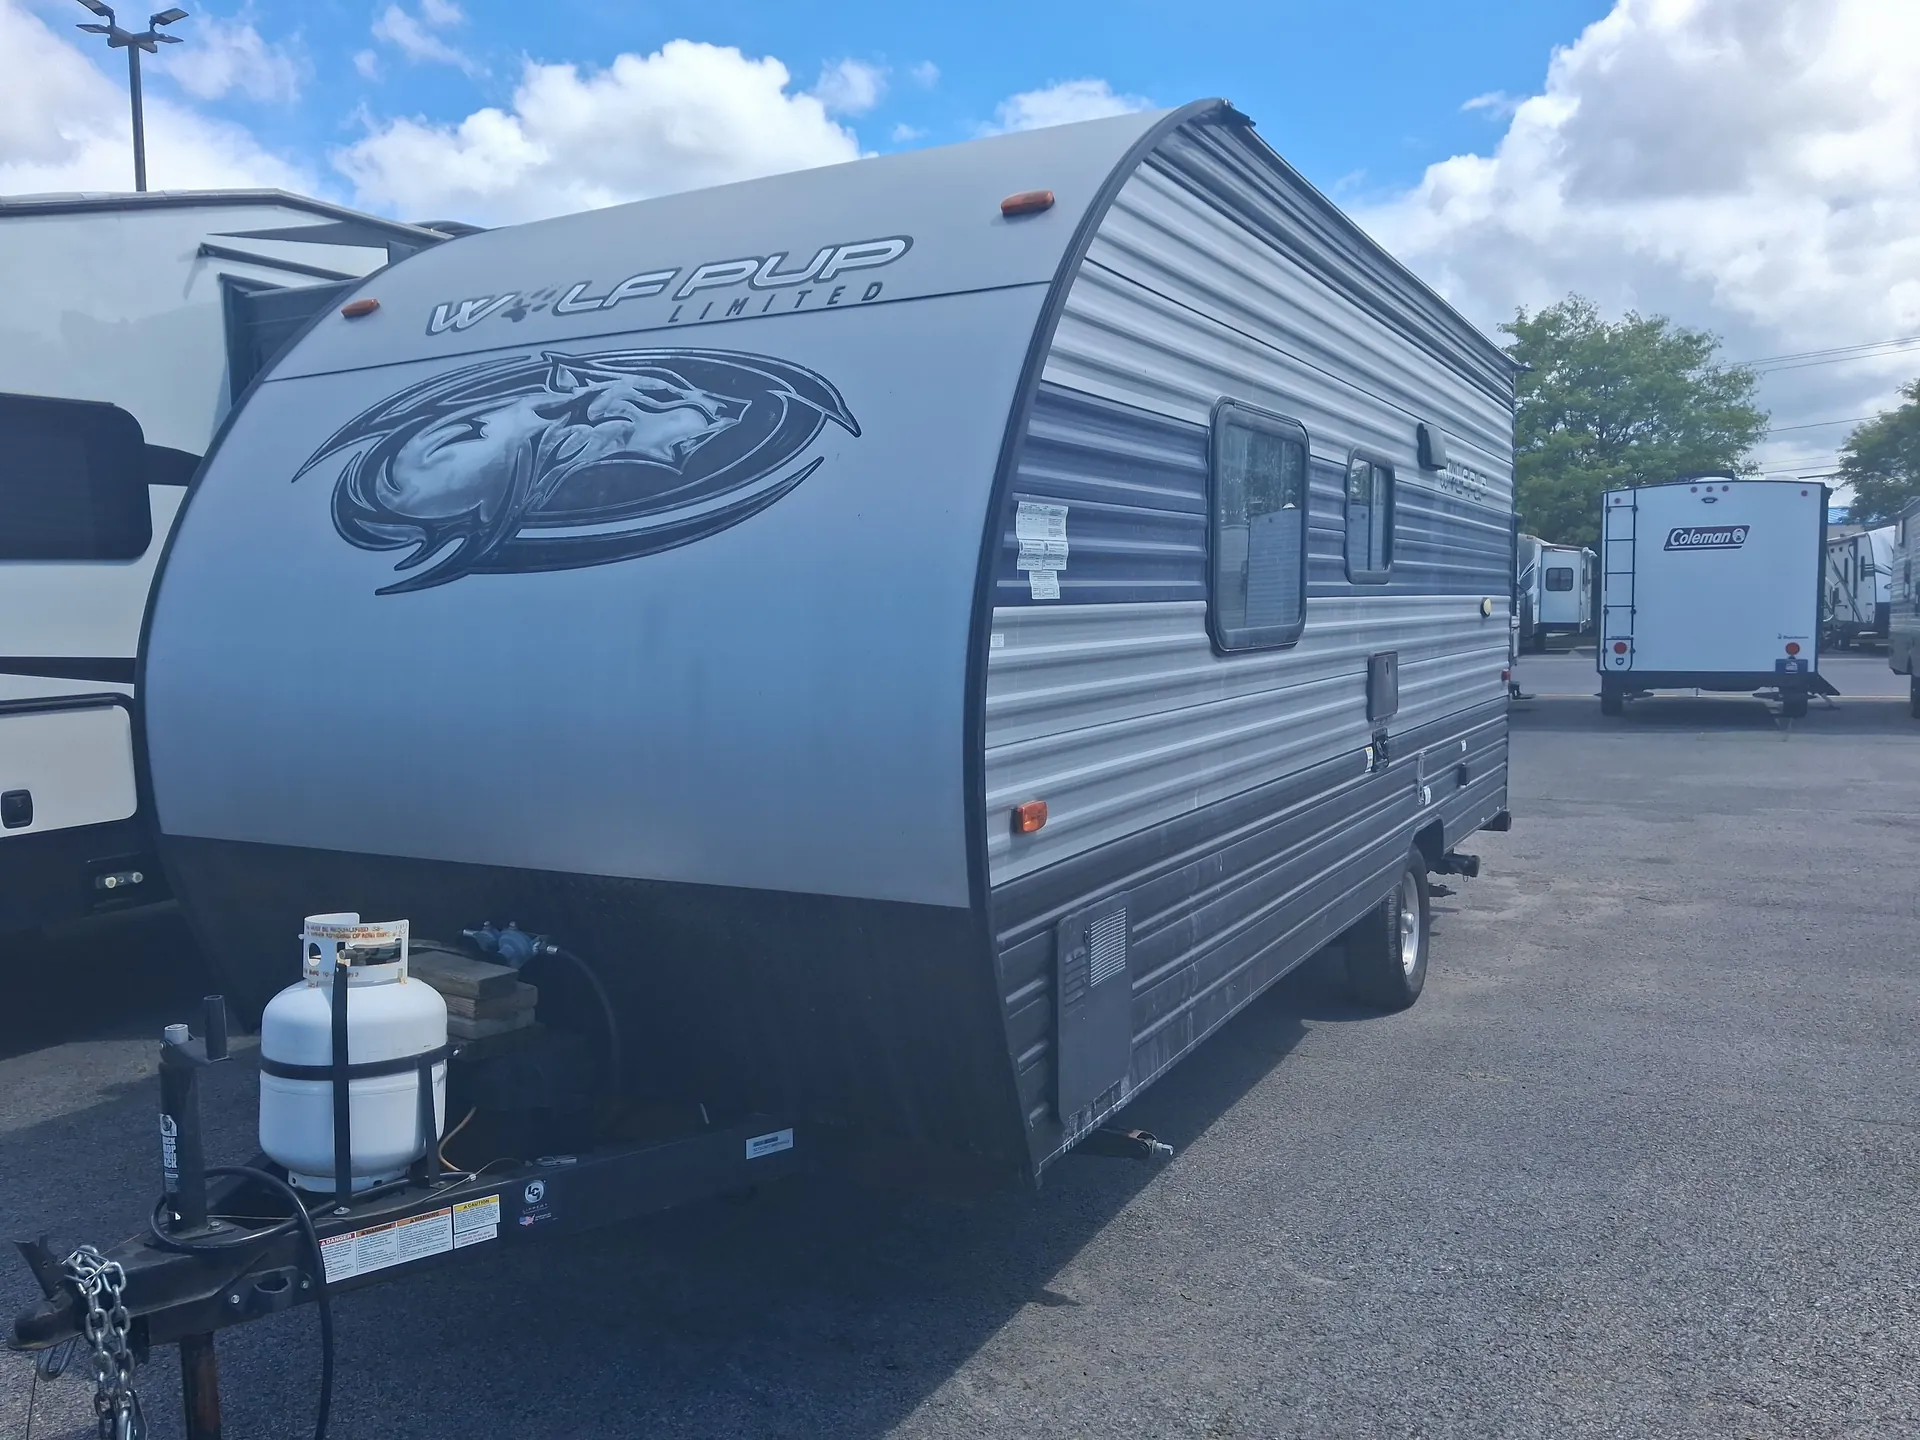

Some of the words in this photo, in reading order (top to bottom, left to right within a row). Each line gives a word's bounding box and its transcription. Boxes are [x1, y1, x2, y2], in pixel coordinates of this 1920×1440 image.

[425, 267, 682, 336] WLF
[668, 281, 884, 323] LIMITED
[1670, 528, 1731, 546] Coleman
[326, 1233, 352, 1245] DANGER
